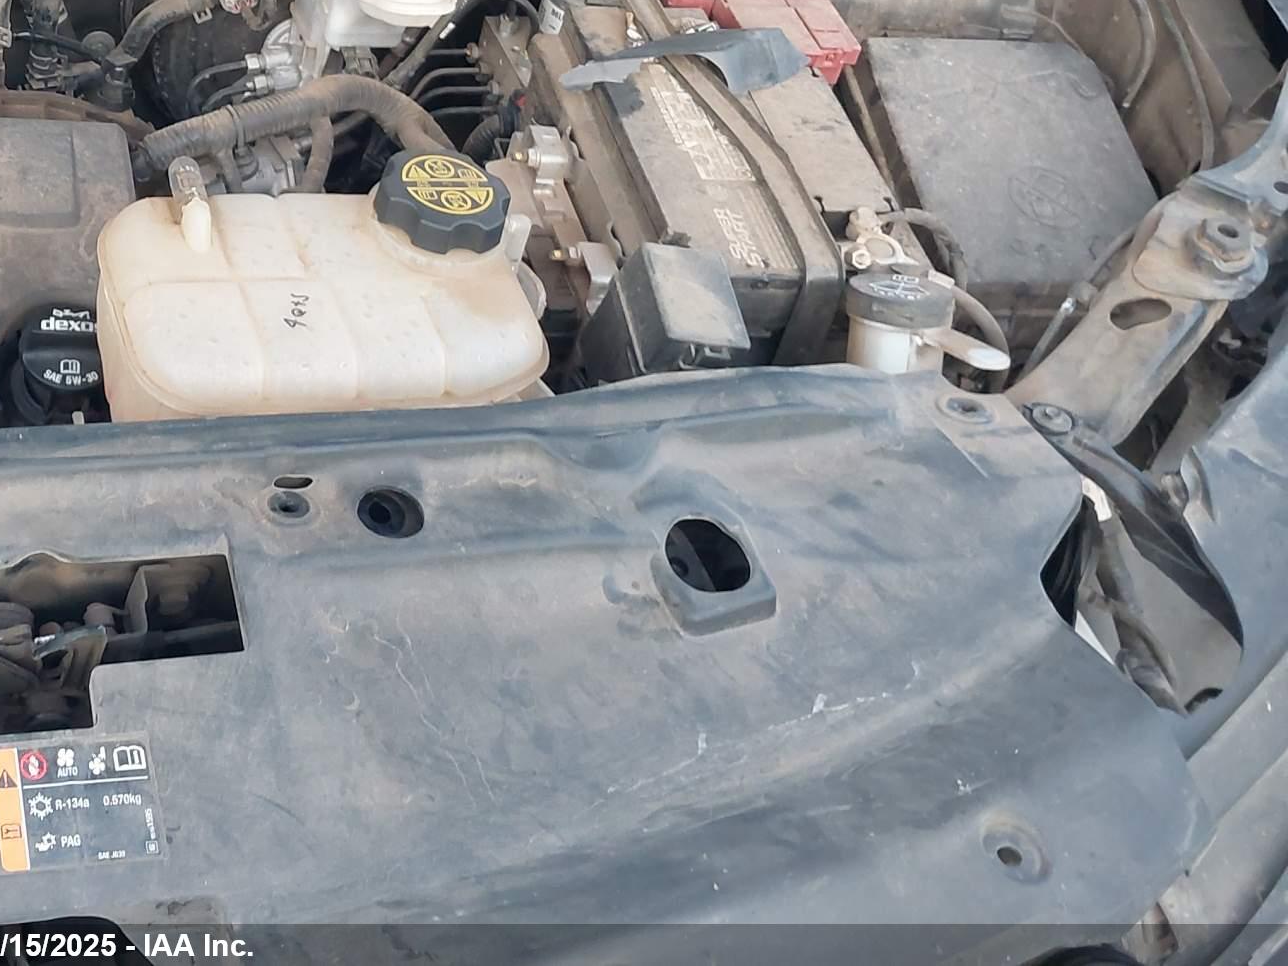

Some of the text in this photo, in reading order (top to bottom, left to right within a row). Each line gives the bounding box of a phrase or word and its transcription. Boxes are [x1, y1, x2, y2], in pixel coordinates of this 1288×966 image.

[43, 368, 99, 386] SAE 5W-30
[57, 766, 79, 778] AUTO
[55, 792, 143, 811] R-134a 0.570kg
[60, 833, 82, 848] PAG
